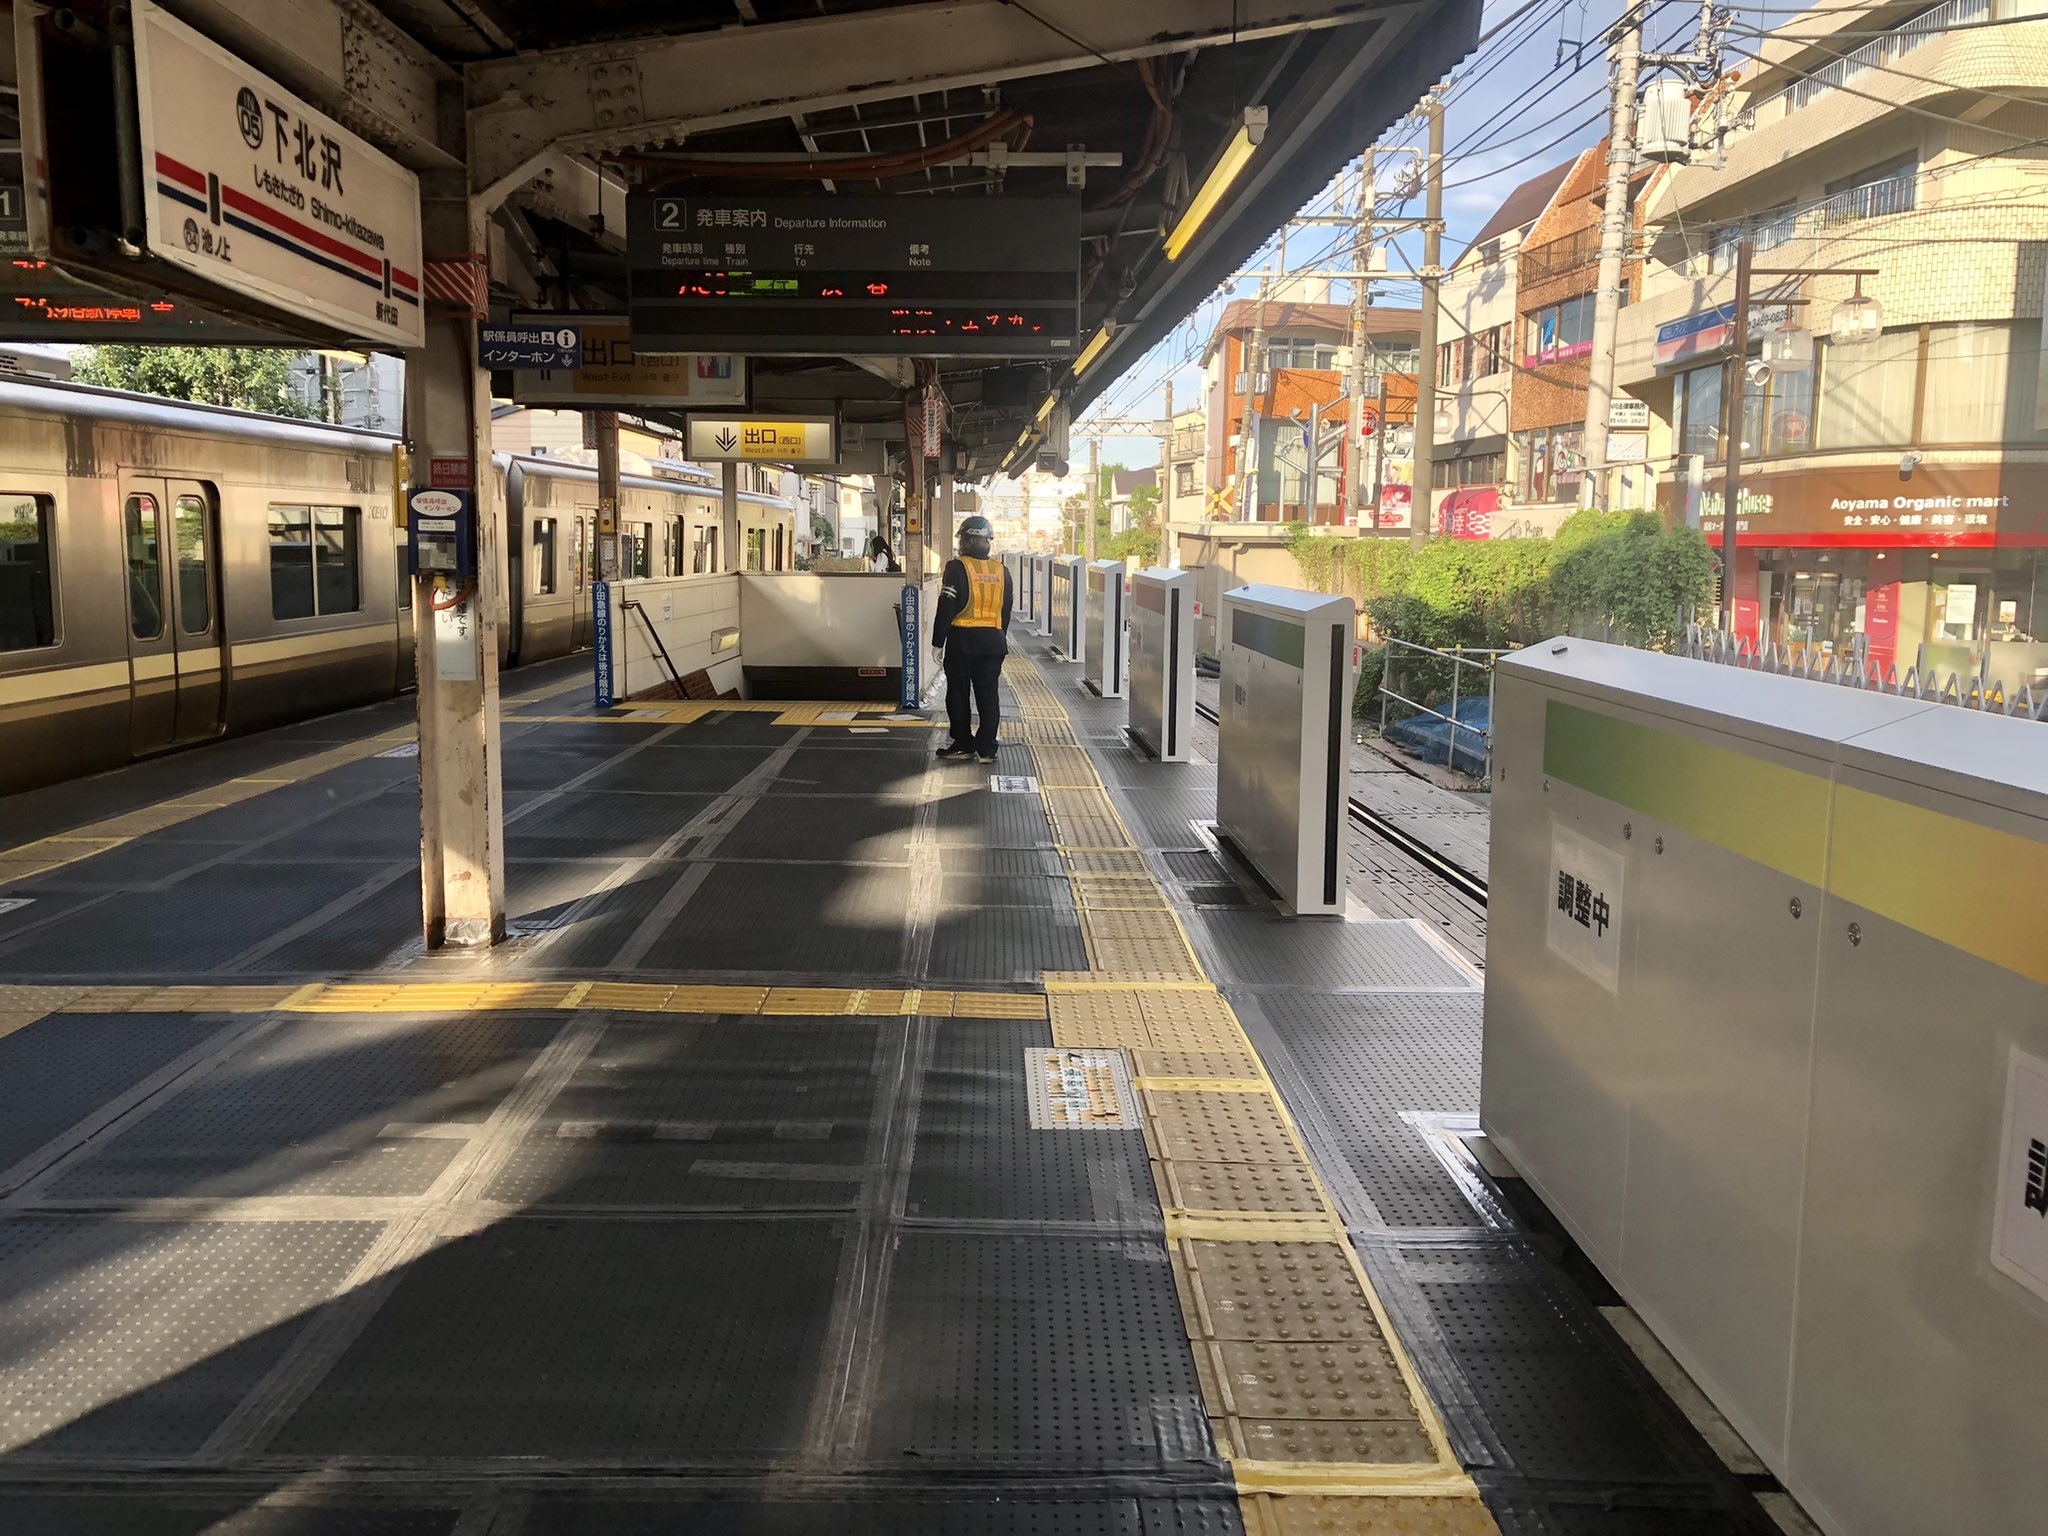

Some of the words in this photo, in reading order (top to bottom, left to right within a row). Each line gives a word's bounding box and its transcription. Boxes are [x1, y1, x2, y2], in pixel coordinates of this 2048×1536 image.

[241, 110, 260, 141] 05
[264, 99, 343, 196] 下北沢
[254, 163, 305, 210] しもきたざわ
[311, 197, 385, 251] Shimo-kitazawa
[661, 202, 680, 227] 2
[696, 208, 767, 227] 発車案内
[774, 217, 826, 229] Departure
[829, 217, 887, 228] Information
[201, 227, 231, 262] 池ノ上
[725, 243, 746, 255] 種別
[794, 244, 815, 255] 行先
[909, 244, 930, 255] 備考
[725, 257, 749, 266] Train
[794, 258, 807, 267] To
[909, 257, 931, 266] Note
[375, 301, 399, 326] 新代田
[483, 331, 540, 345] 駅係員呼出
[484, 350, 555, 363] インターホン
[611, 372, 632, 382] Exit
[744, 428, 776, 445] 出口
[1831, 497, 1889, 512] Aoyama
[1893, 496, 1962, 511] Organic
[1966, 495, 2010, 508] mart
[596, 583, 609, 704] 小田急線のりかえは後方階段へ
[905, 587, 916, 708] 小田急線のりかえは後方階段へ
[1558, 870, 1610, 938] 調整中
